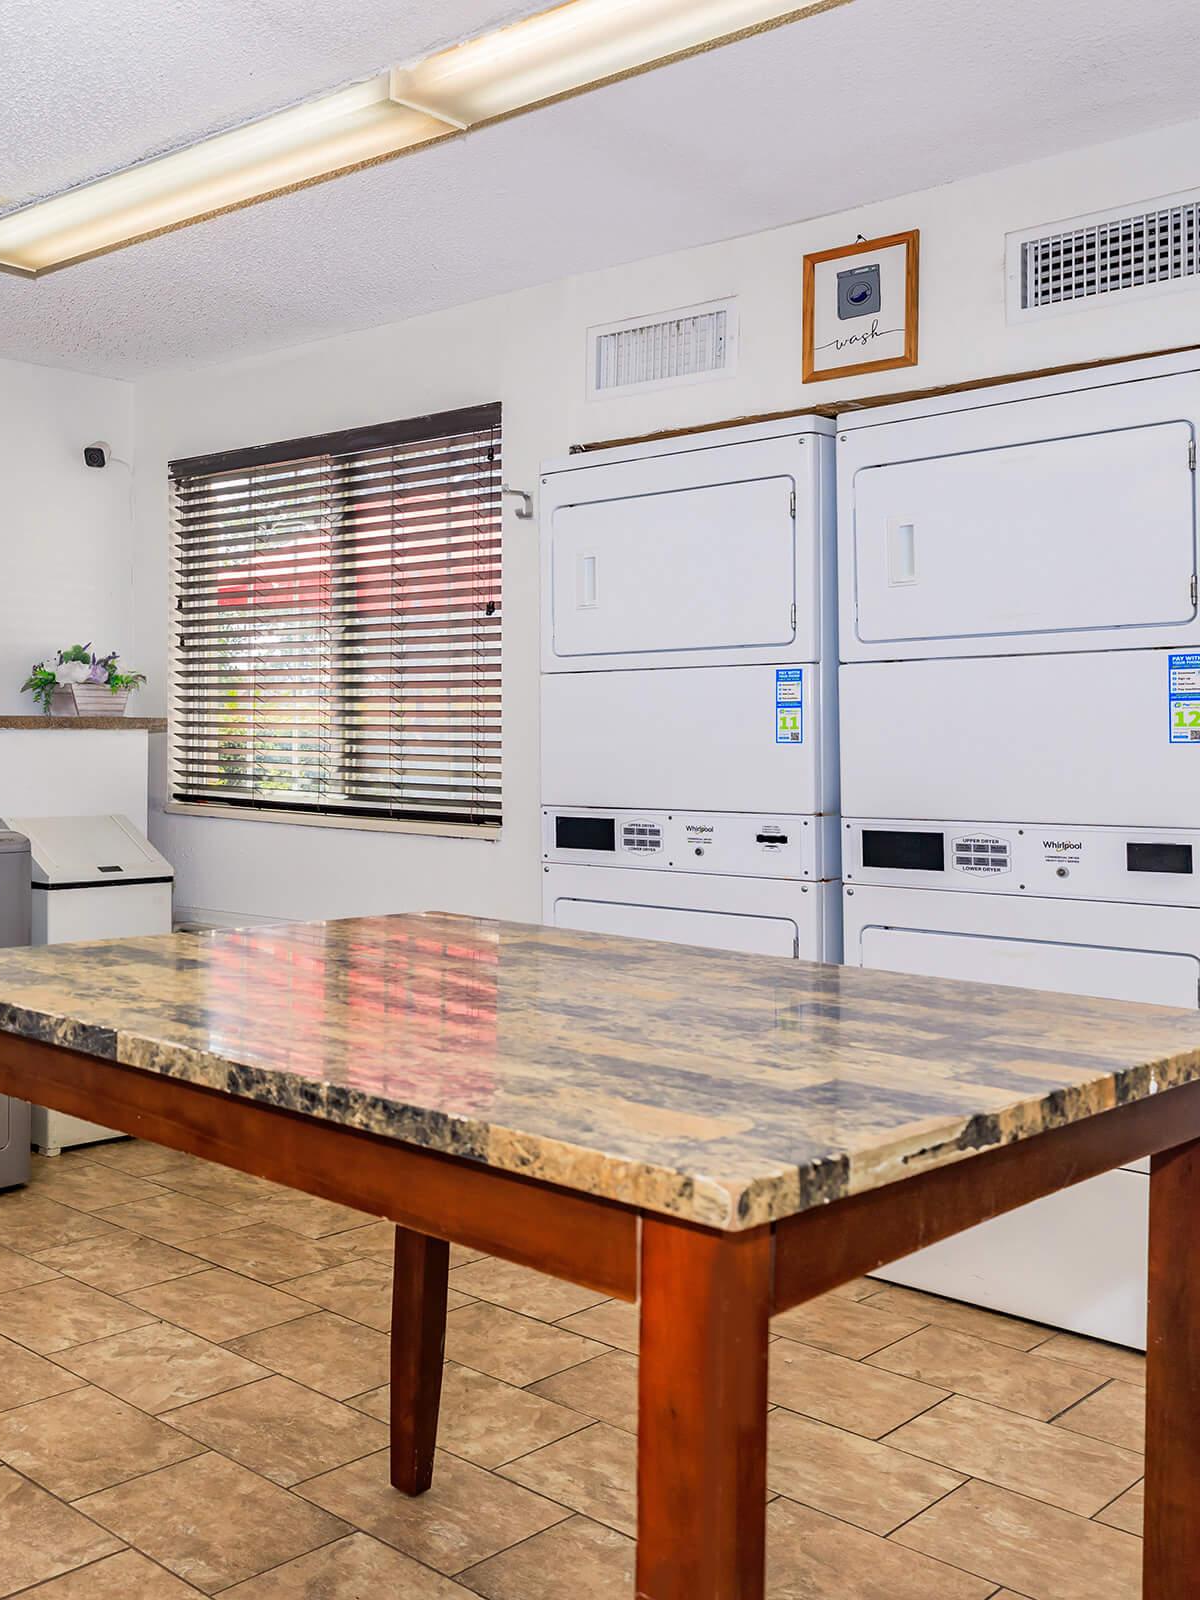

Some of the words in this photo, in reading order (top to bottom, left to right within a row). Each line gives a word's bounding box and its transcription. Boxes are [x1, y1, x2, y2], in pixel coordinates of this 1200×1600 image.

[830, 319, 886, 350] wash
[780, 716, 799, 730] 11
[1173, 711, 1200, 727] 12
[686, 825, 714, 833] Whirlpool
[1042, 840, 1082, 850] Whirlpool
